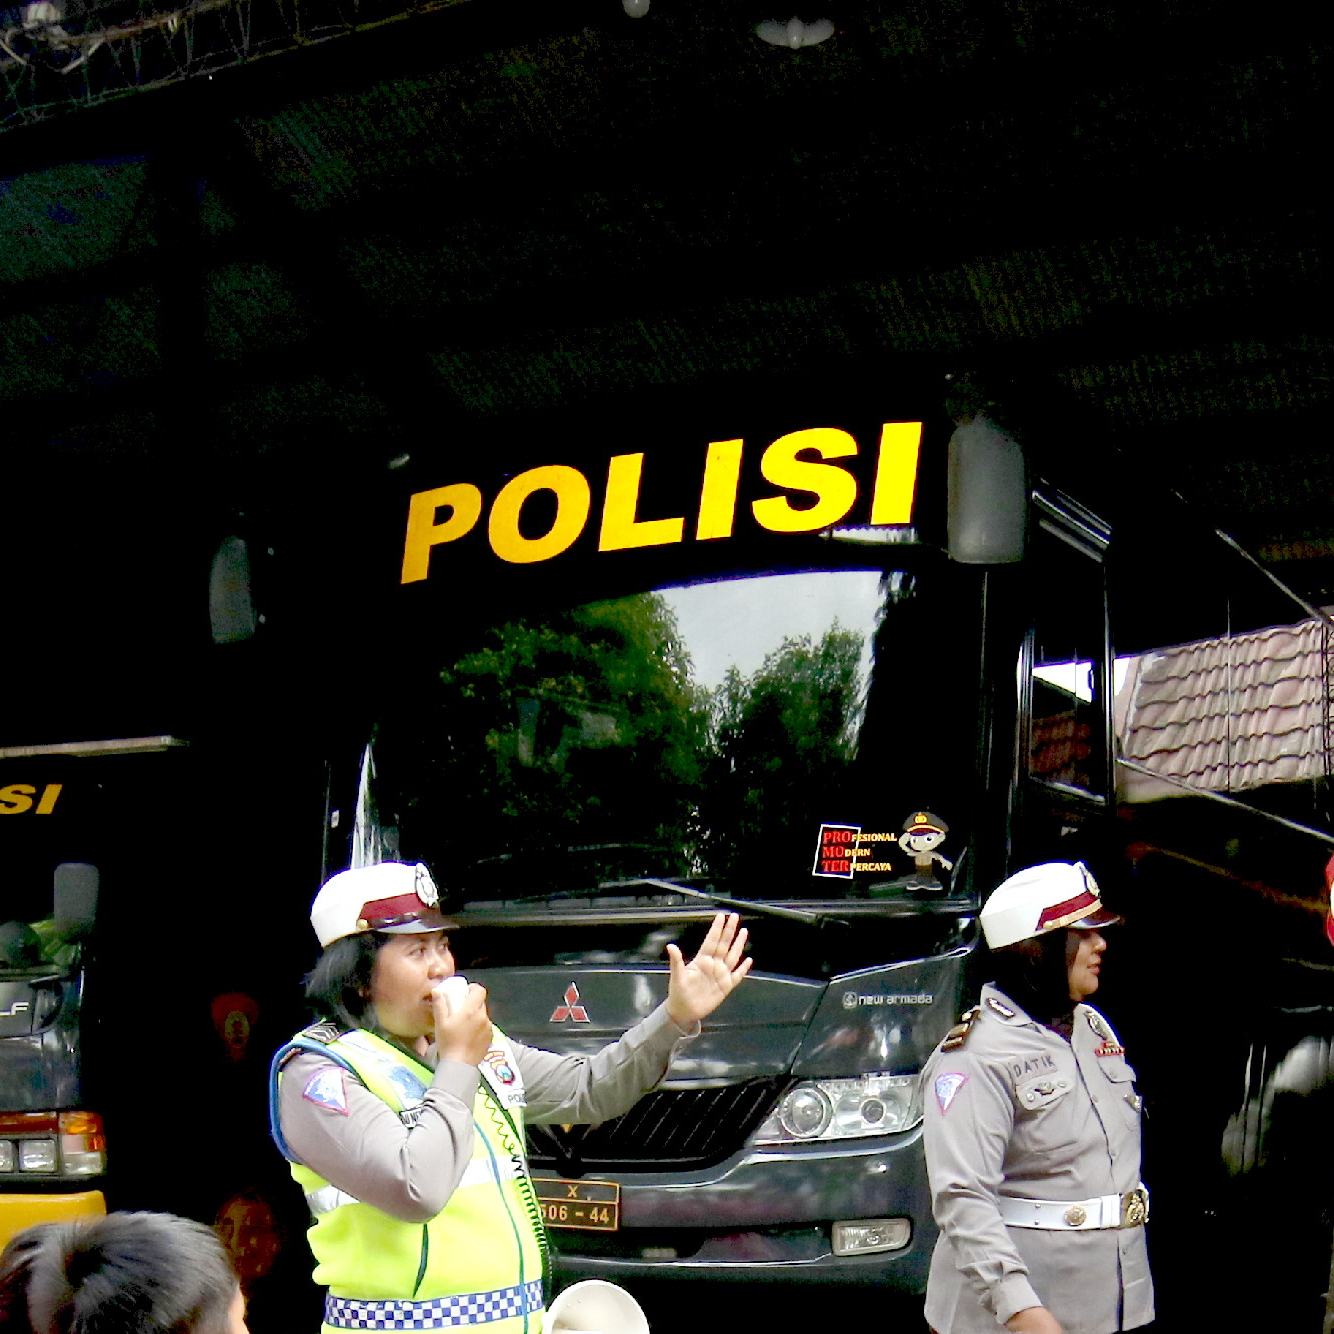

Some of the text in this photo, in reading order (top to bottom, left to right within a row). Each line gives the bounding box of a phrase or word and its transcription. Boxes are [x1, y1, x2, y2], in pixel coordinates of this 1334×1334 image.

[401, 421, 922, 584] POLISI
[823, 831, 897, 844] PROFESIONAL
[822, 845, 871, 858] MODERN
[821, 860, 892, 872] TERPERCAYA
[858, 992, 933, 1006] new armada
[1013, 1055, 1057, 1078] DATIK
[568, 1185, 579, 1198] X
[589, 1206, 611, 1224] 44
